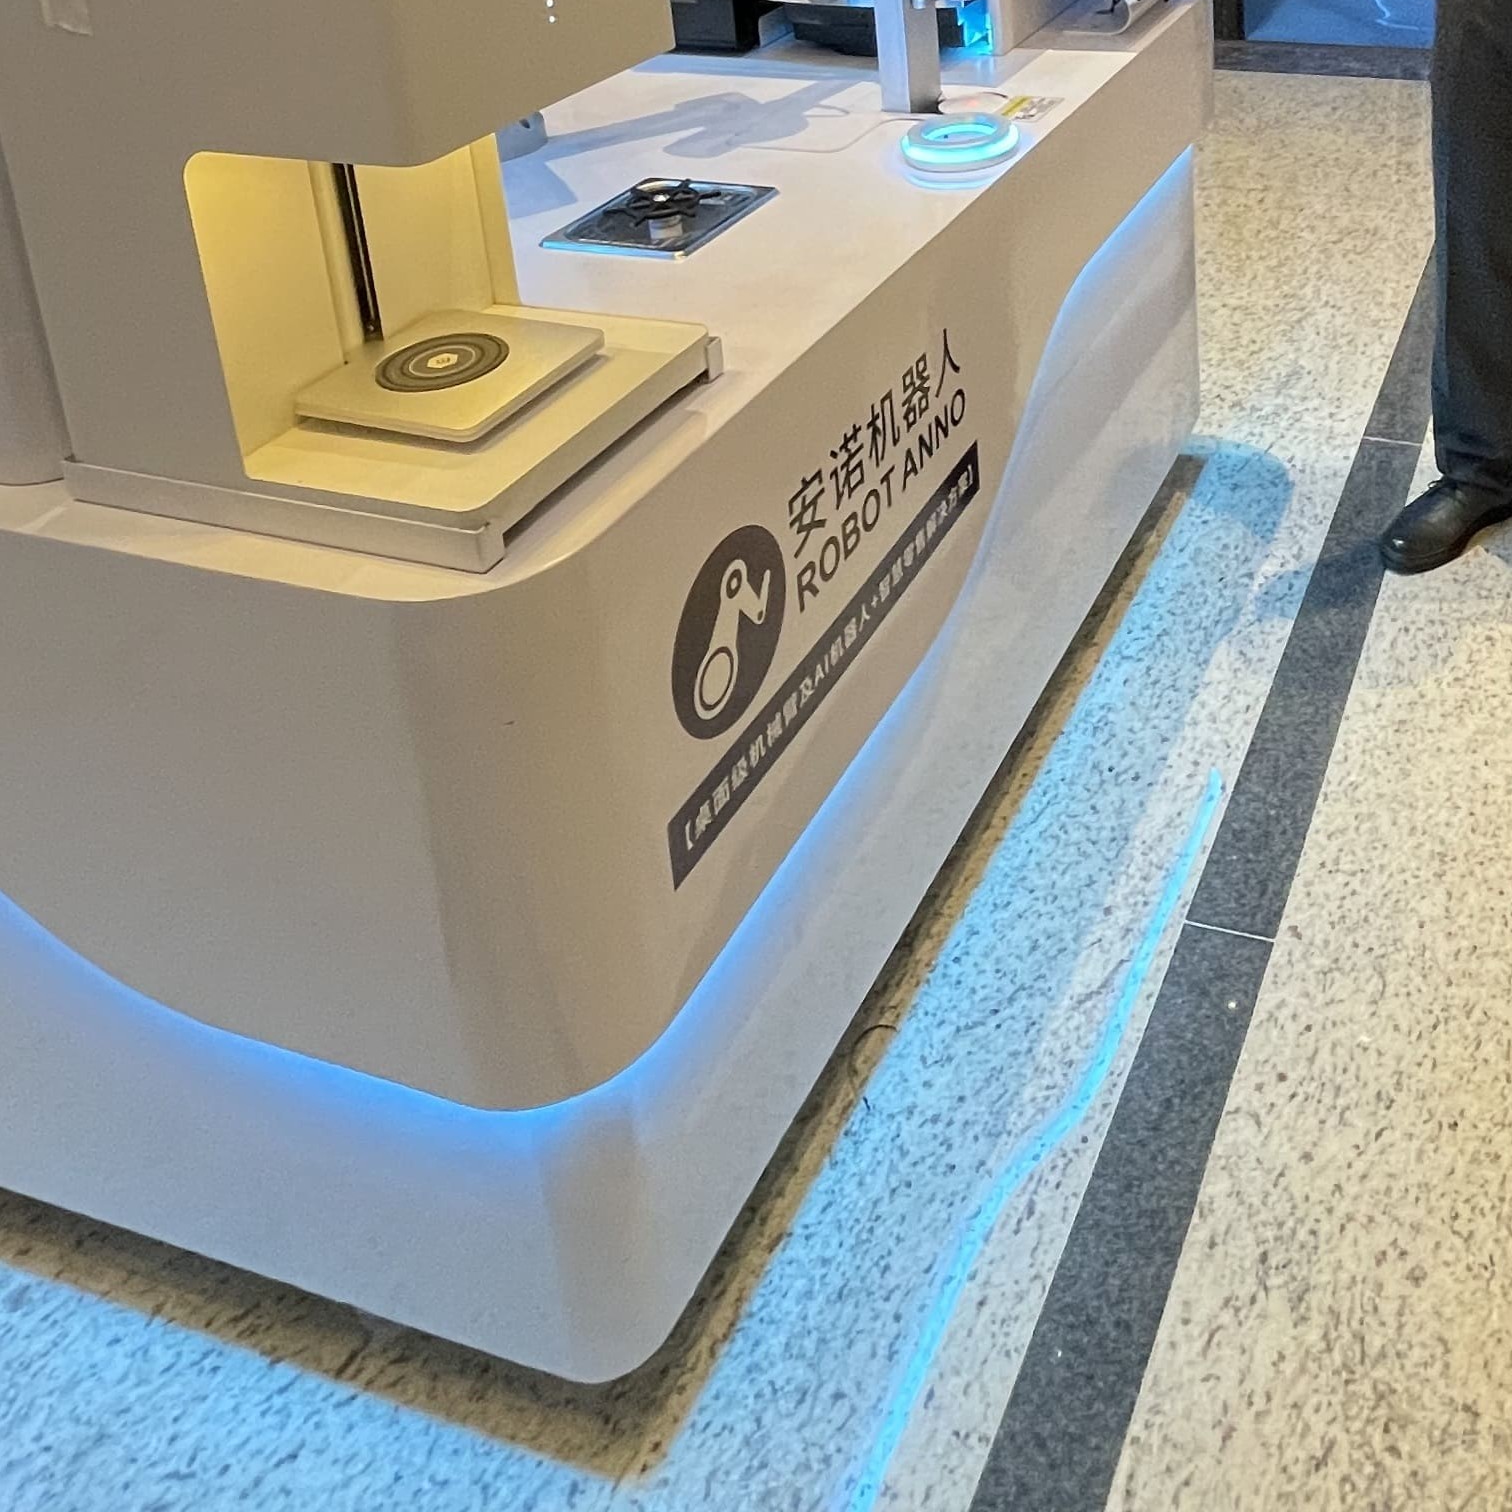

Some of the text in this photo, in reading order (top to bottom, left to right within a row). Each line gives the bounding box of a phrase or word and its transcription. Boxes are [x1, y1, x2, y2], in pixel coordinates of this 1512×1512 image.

[788, 328, 961, 559] 安诺机器人
[797, 388, 966, 612] ROBOT ANNO
